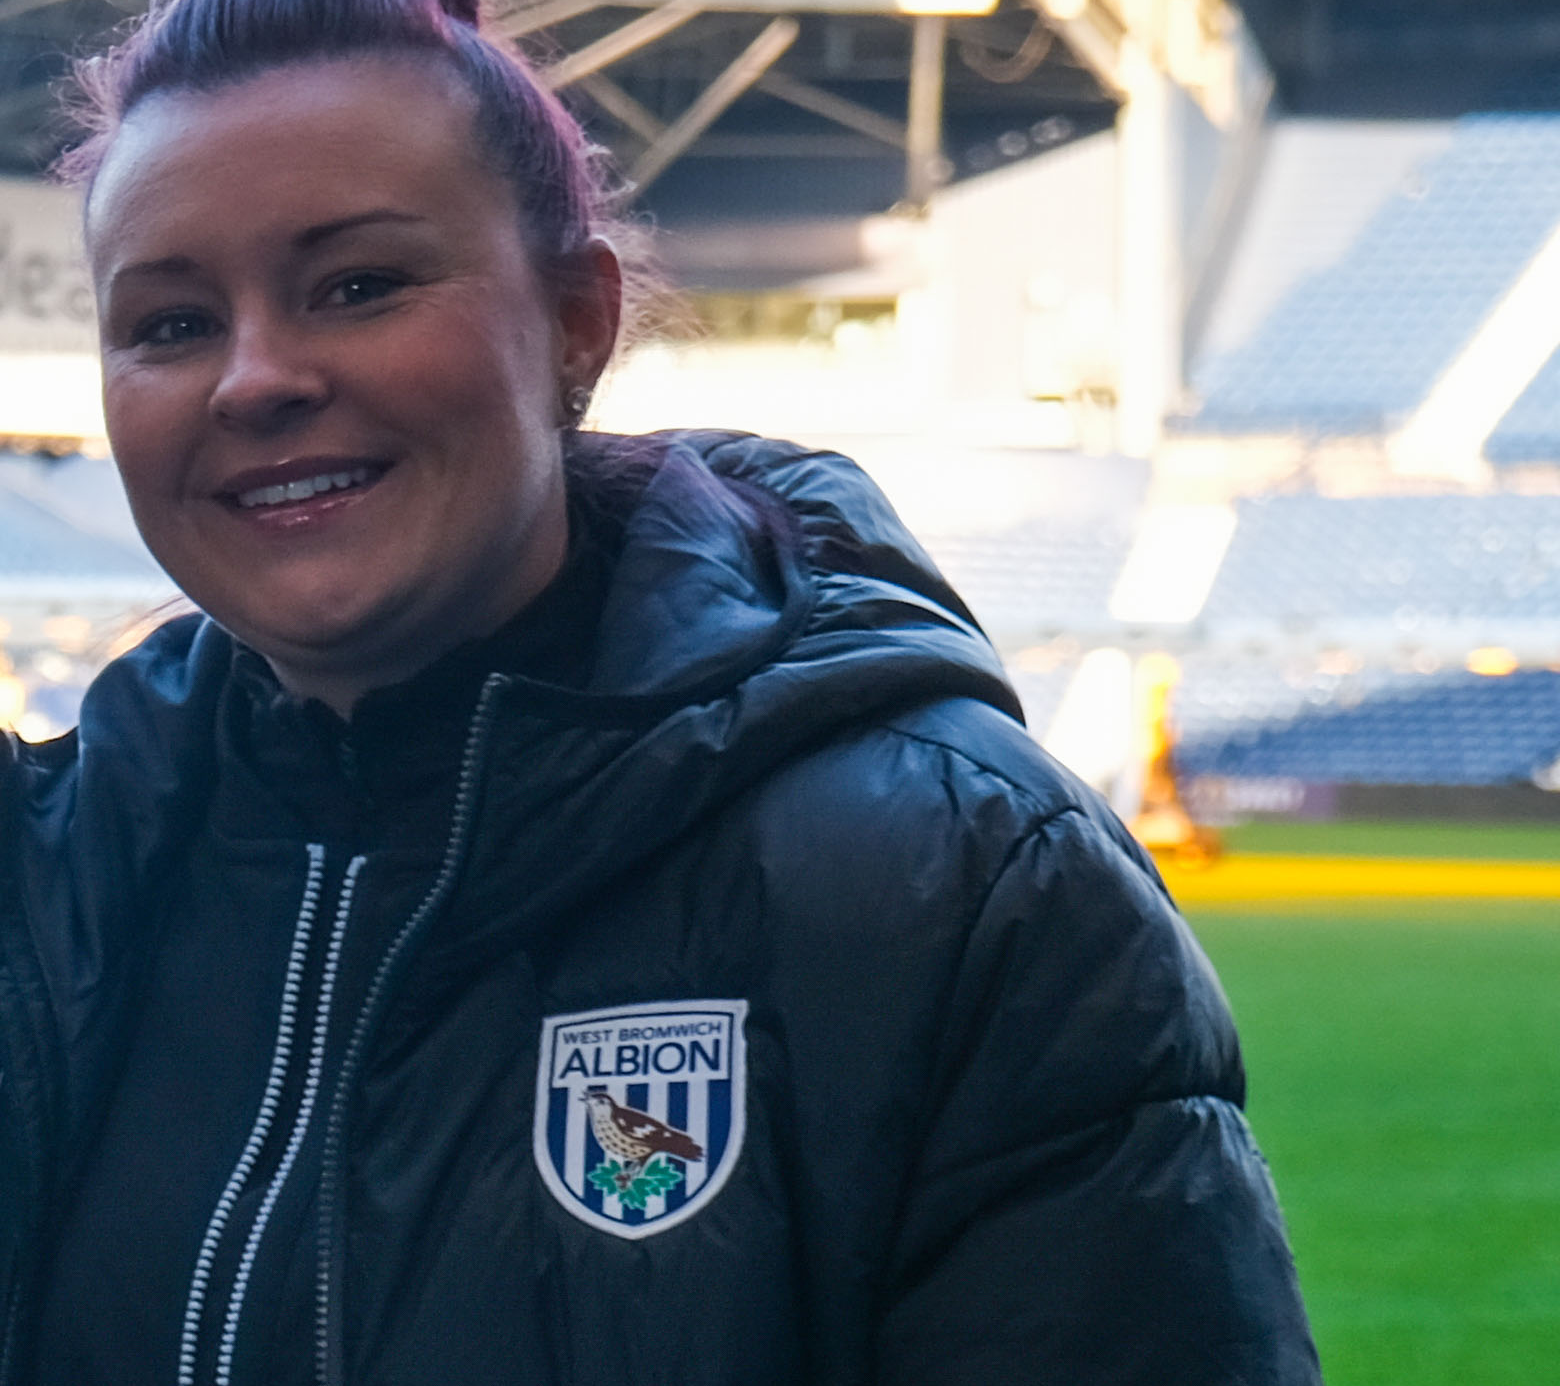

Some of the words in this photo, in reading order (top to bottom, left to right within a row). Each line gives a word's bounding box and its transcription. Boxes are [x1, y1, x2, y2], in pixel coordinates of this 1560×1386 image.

[563, 1029, 613, 1044] WEST
[619, 1021, 722, 1043] BROMWICH
[559, 1039, 721, 1079] ALBION
